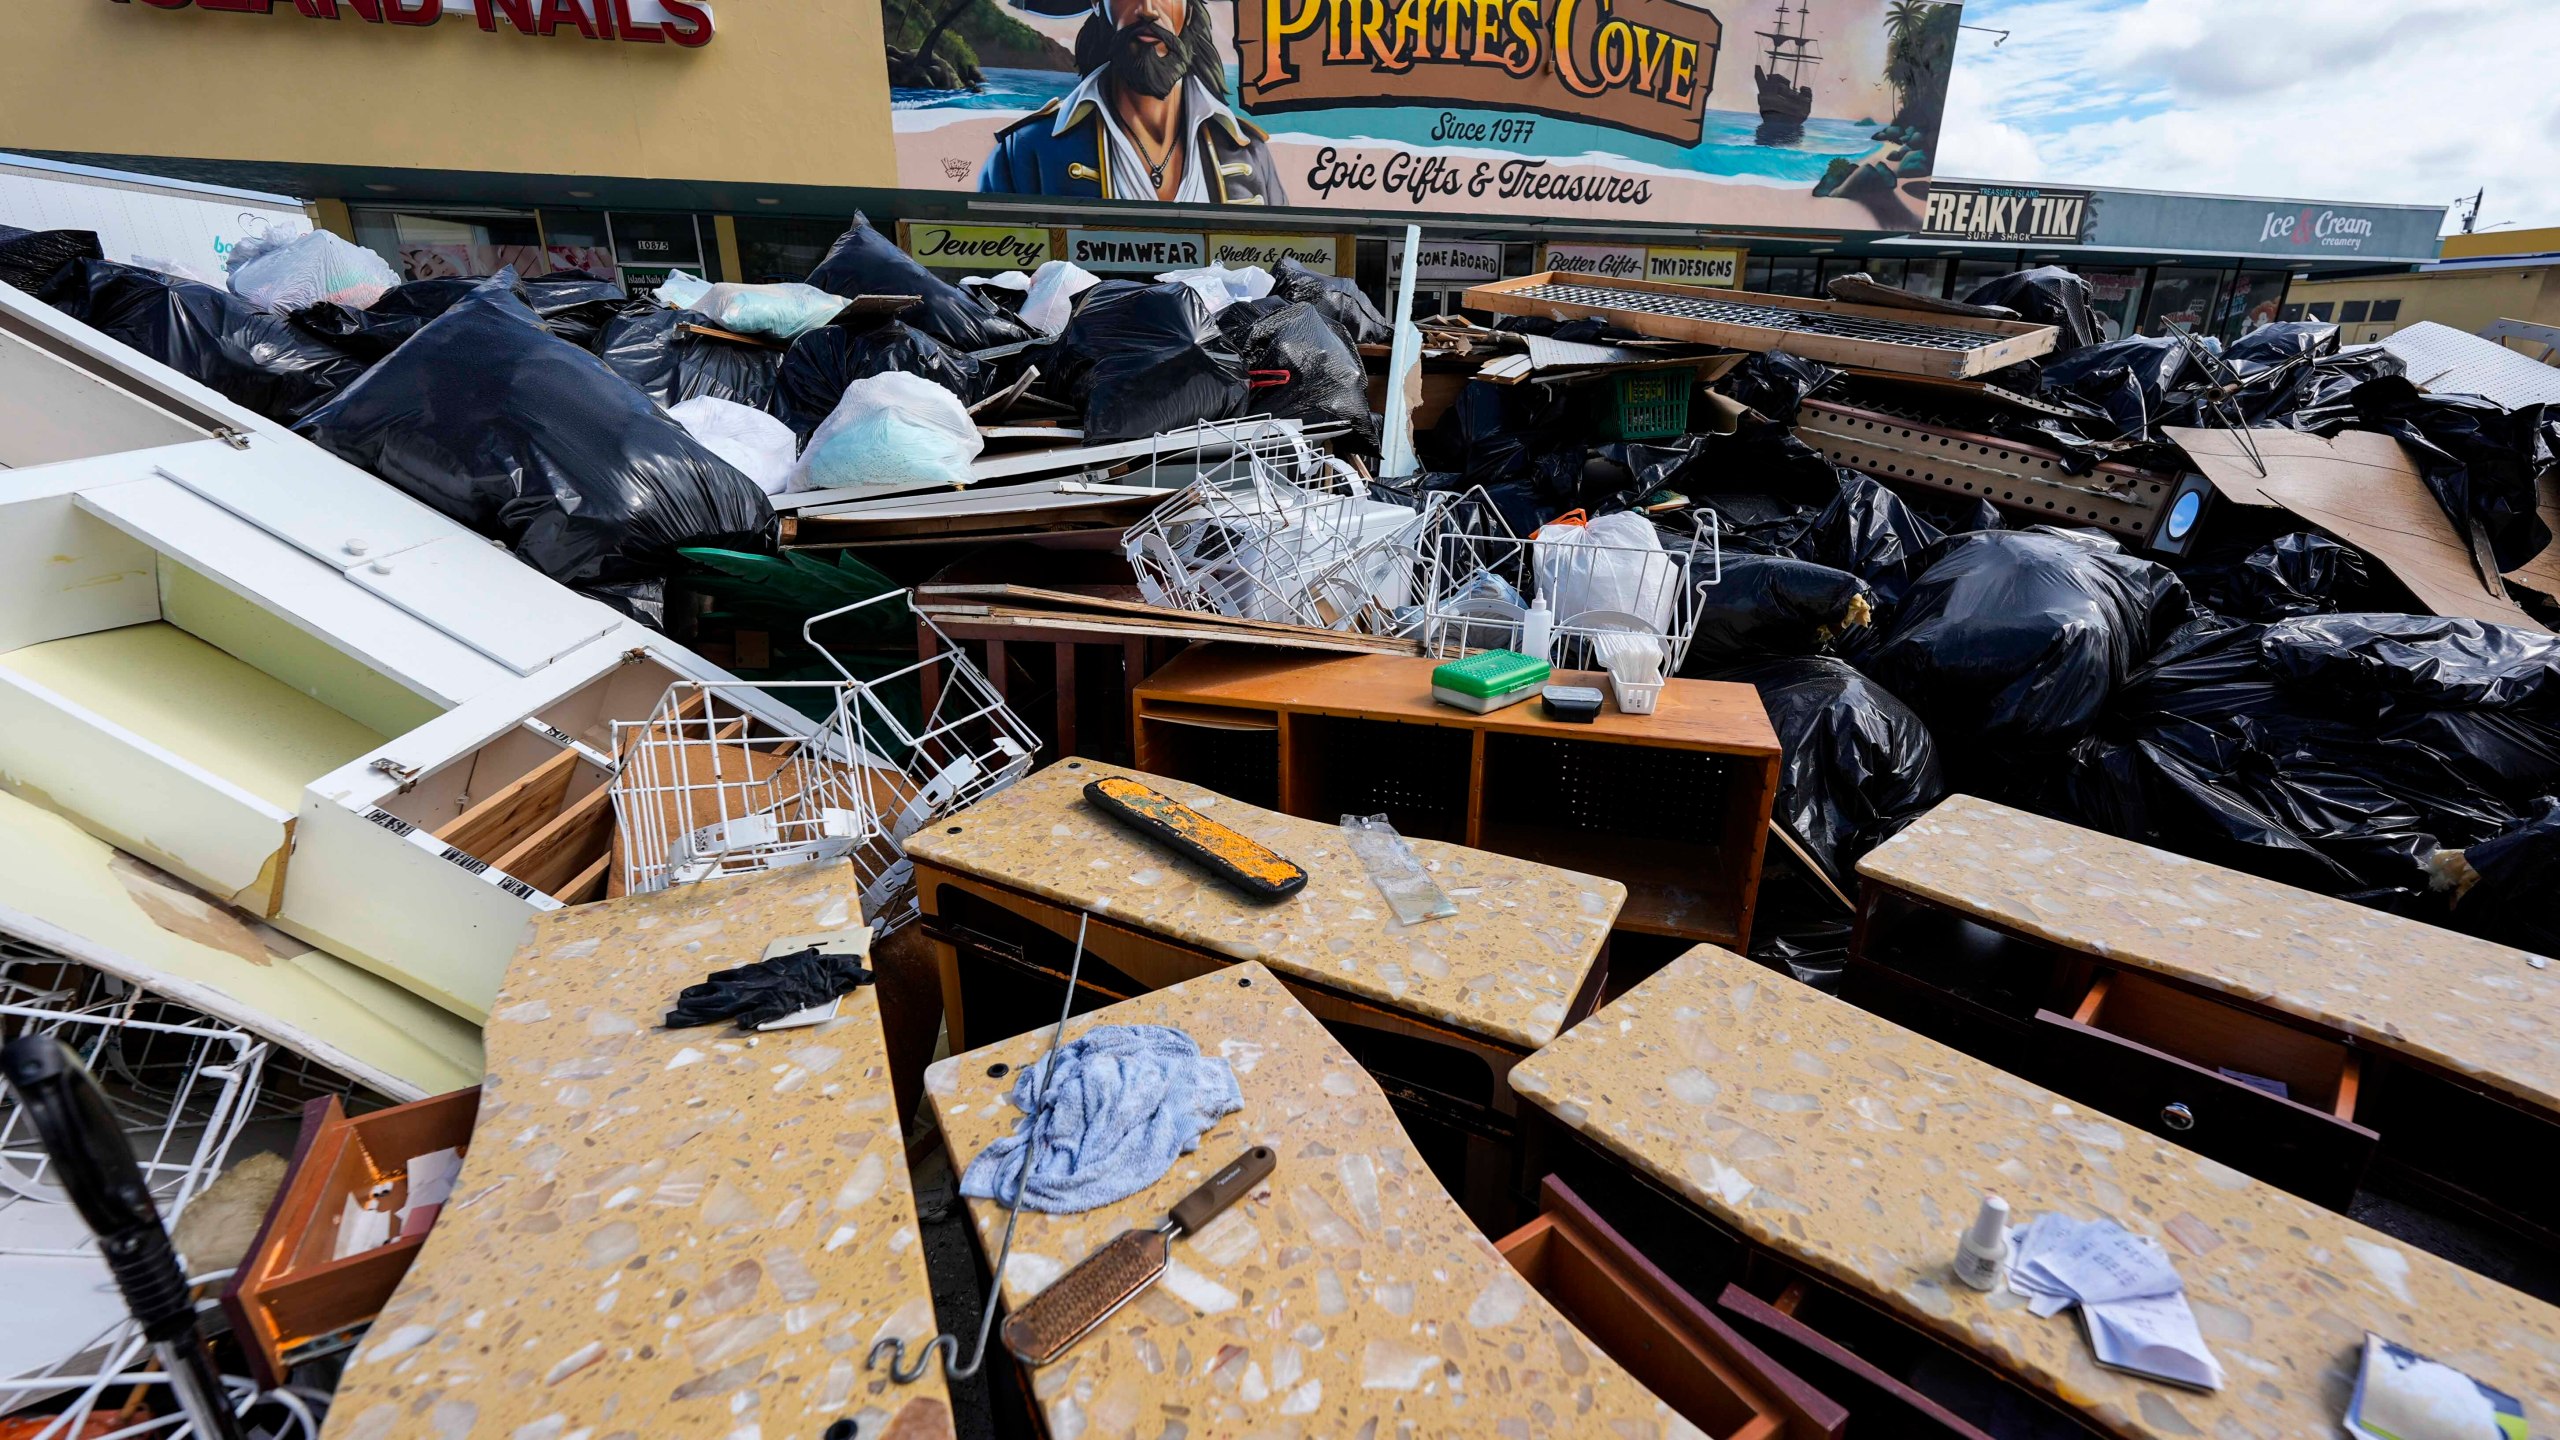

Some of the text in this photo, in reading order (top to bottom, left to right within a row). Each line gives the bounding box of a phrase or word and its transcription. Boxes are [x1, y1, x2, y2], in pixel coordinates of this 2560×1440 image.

[1431, 112, 1535, 144] Since 1977
[1306, 147, 1653, 206] Epic Gifts & Treasures
[1980, 188, 2040, 199] TREASURE ISLAND
[1922, 192, 2083, 236] FREAKY TIKI
[1966, 231, 2032, 242] SURF SHACK
[2260, 208, 2373, 245] Ice & Cream
[213, 235, 233, 254] bo
[638, 240, 669, 250] 10875
[918, 229, 1045, 267] Jewelry
[1075, 239, 1199, 265] SWIMWEAR
[1215, 244, 1262, 263] Shells
[1263, 247, 1278, 263] &
[2321, 237, 2361, 251] creamery
[1391, 249, 1497, 274] WCOME ABOARD
[1547, 251, 1642, 278] Better Gifts
[1651, 257, 1733, 278] TIKI DESIGNS
[627, 275, 645, 284] Island
[646, 275, 661, 283] Nails
[632, 287, 649, 296] 727
[546, 729, 575, 744] SUN
[367, 809, 415, 838] CASH
[442, 847, 489, 875] THUR
[499, 876, 534, 900] FRI
